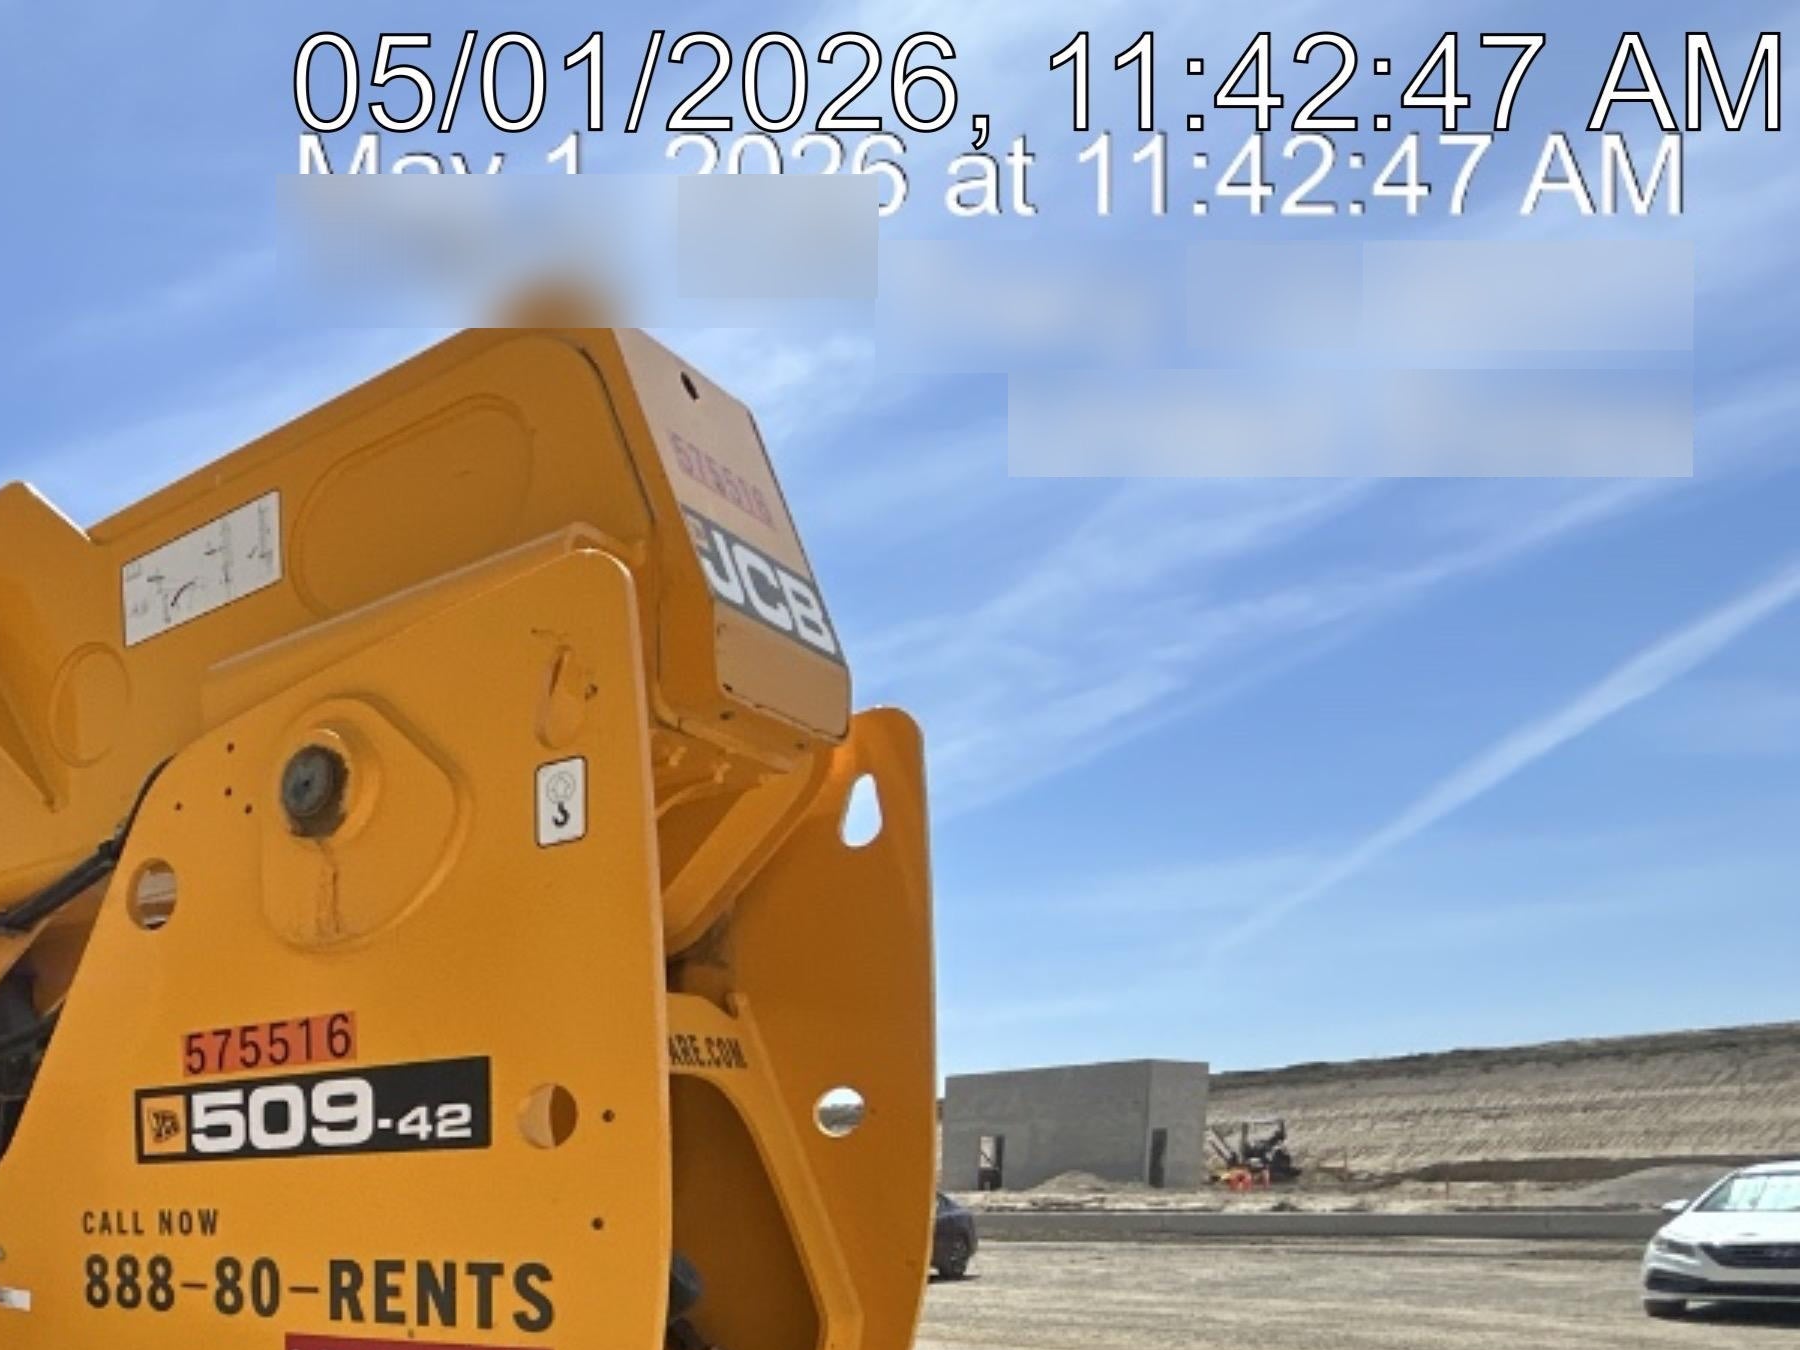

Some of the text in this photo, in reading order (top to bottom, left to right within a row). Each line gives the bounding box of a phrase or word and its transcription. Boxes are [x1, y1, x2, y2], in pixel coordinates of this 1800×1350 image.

[184, 1012, 353, 1075] 575516
[83, 1208, 219, 1236] CALL NOW
[84, 1253, 555, 1332] 888-80-RENTS
